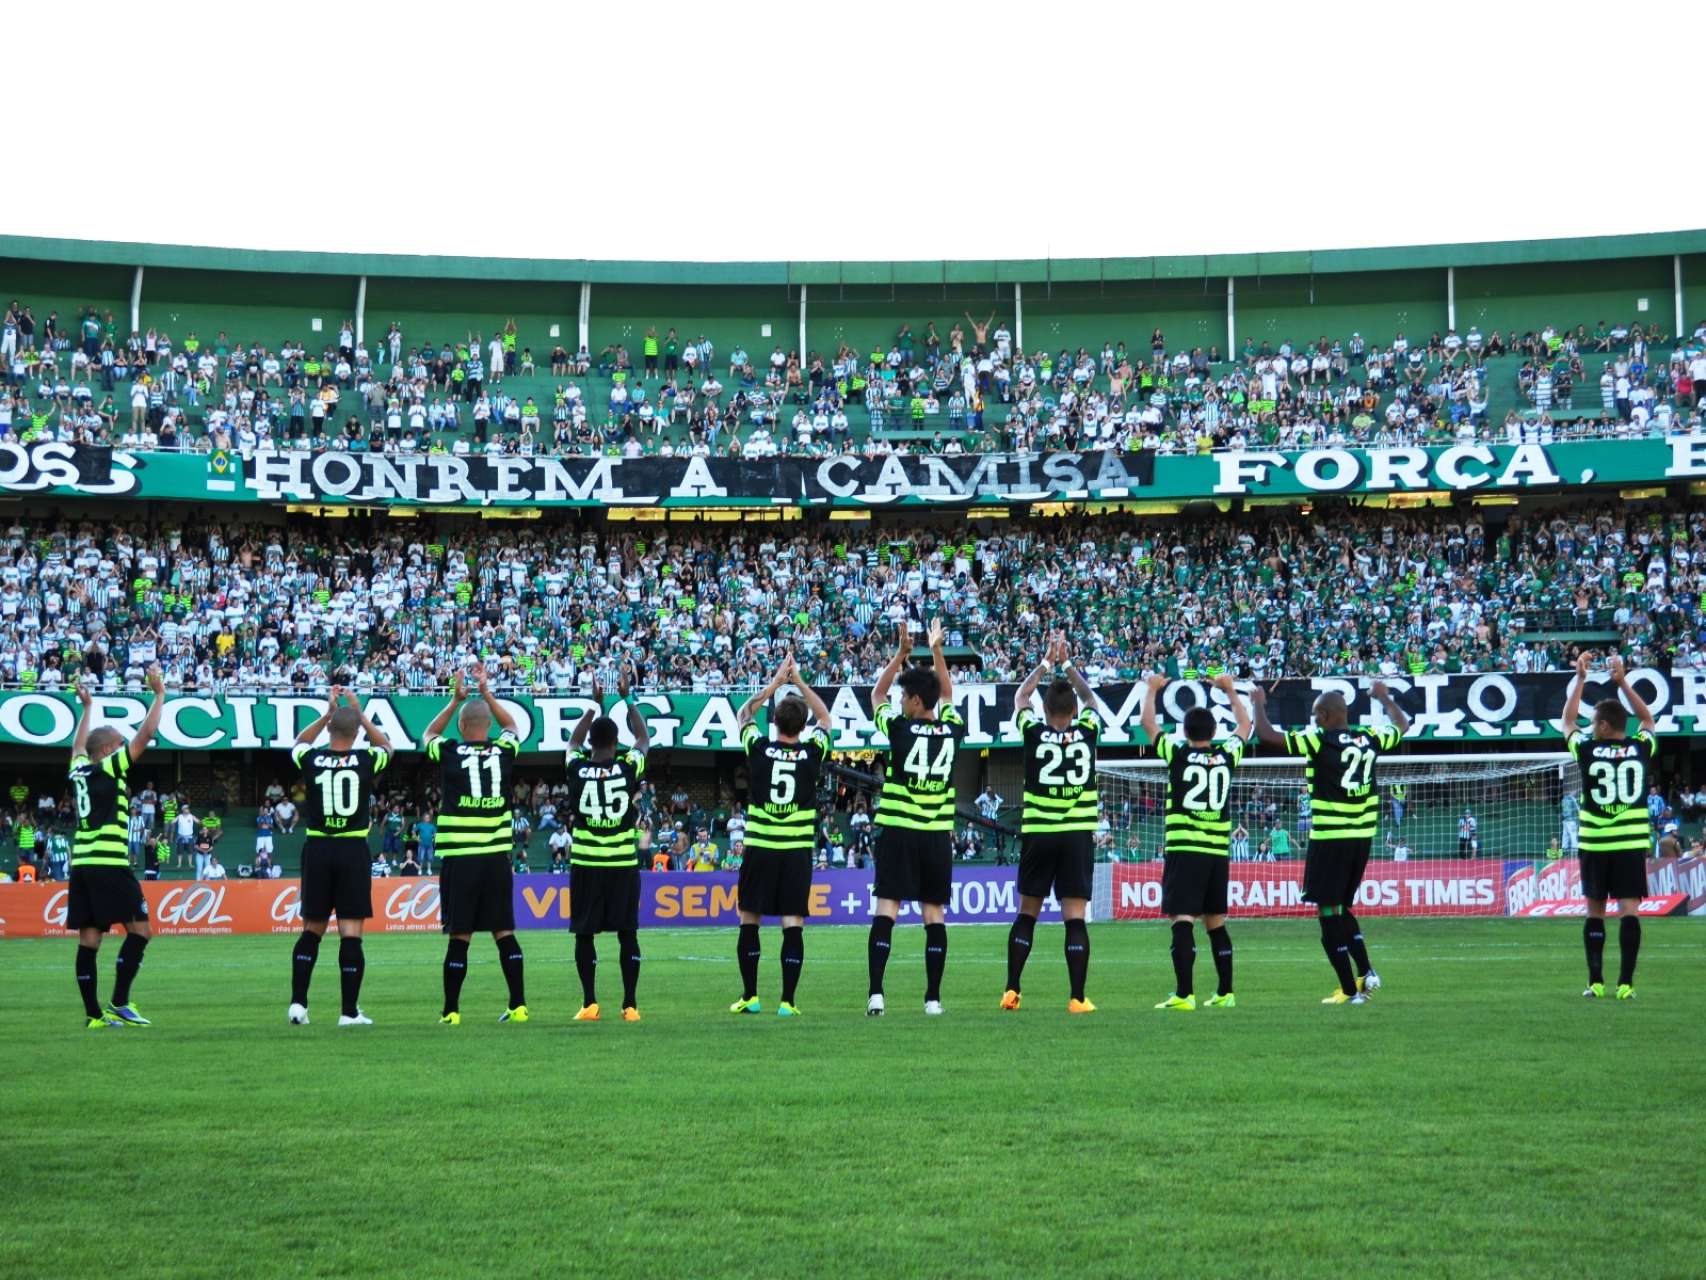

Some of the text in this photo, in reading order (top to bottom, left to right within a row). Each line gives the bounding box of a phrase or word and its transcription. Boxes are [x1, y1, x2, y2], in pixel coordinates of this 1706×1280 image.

[246, 449, 1139, 499] HONREM A CAMISA
[764, 747, 808, 761] CAIXA
[1040, 729, 1085, 744] CAIXA
[1338, 733, 1371, 748] CAXA
[1591, 745, 1638, 759] CAIXA
[314, 754, 360, 768] CAIXA
[461, 755, 502, 798] 11
[578, 764, 622, 779] CAIXA
[903, 735, 956, 784] 44
[1035, 741, 1091, 785] 23
[1340, 746, 1375, 790] 21
[315, 769, 360, 816] 10
[578, 777, 630, 823] 45
[770, 760, 797, 805] 5
[1182, 765, 1232, 811] 20
[1588, 760, 1644, 806] 30
[324, 816, 349, 829] ALEX
[157, 885, 233, 925] GOL
[385, 884, 441, 922] GO
[654, 884, 832, 918] SEME
[1226, 880, 1319, 907] RAHM
[1353, 879, 1399, 907] OS
[1404, 878, 1496, 906] TIMES
